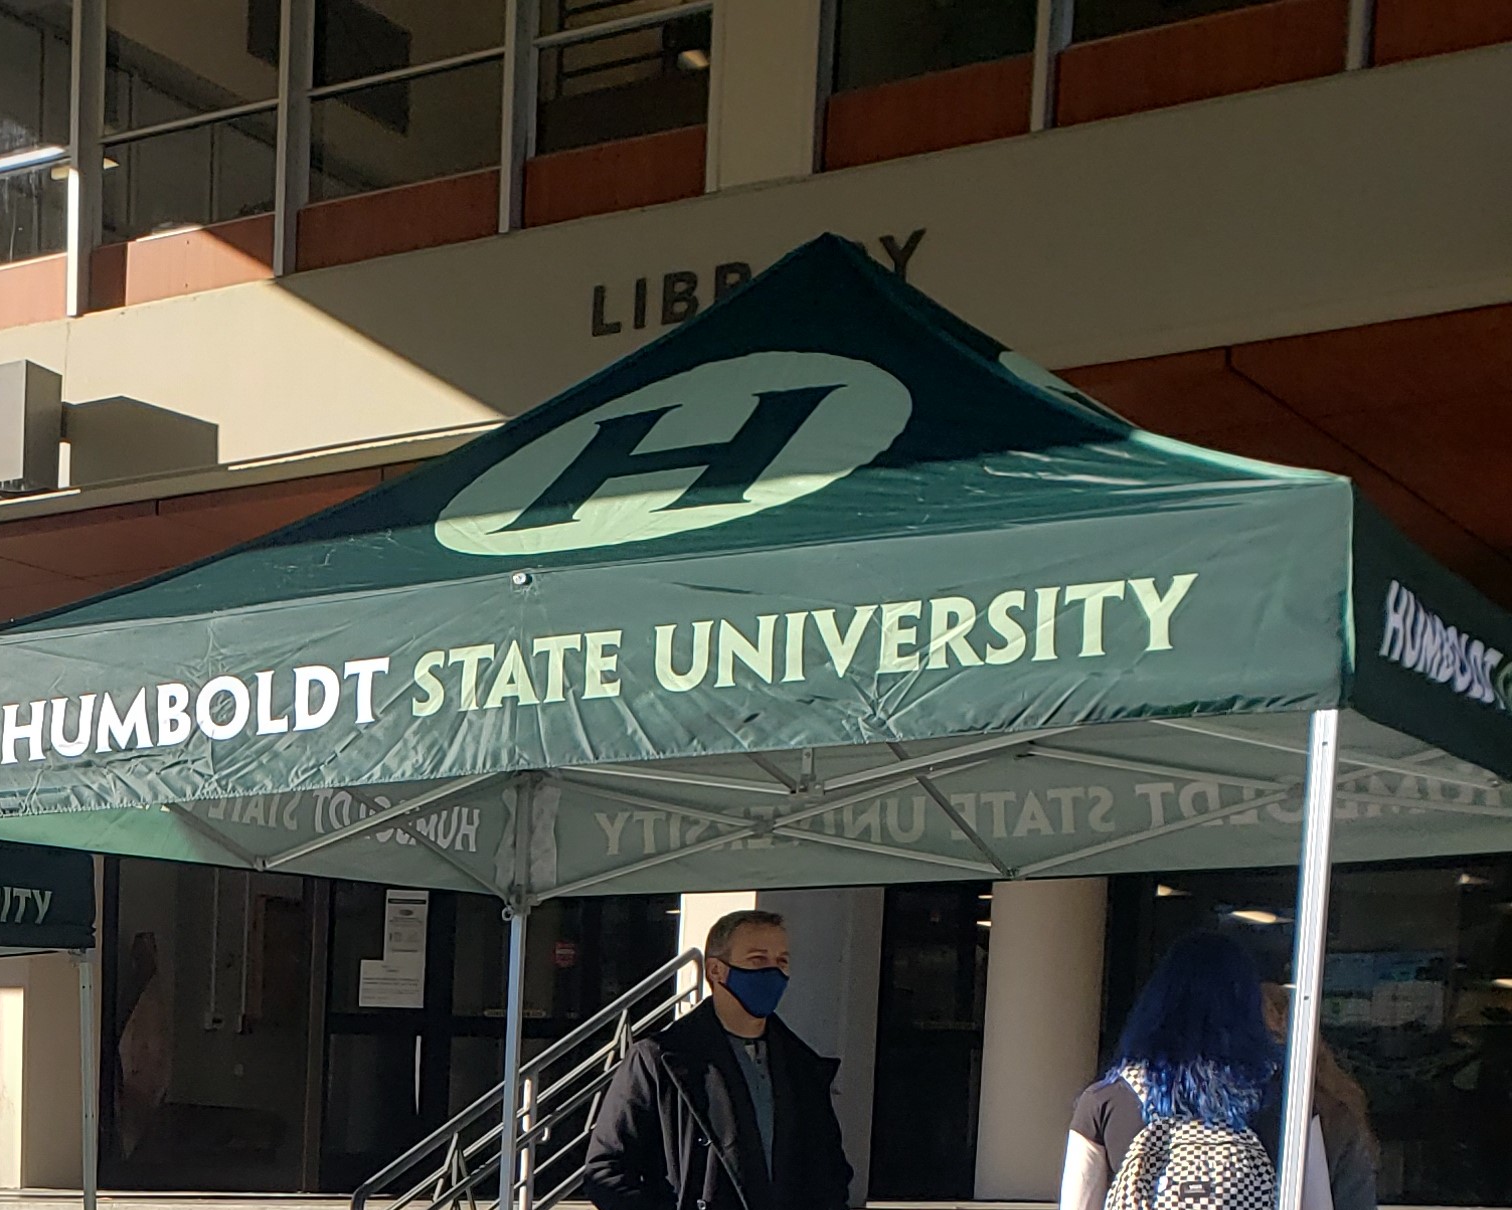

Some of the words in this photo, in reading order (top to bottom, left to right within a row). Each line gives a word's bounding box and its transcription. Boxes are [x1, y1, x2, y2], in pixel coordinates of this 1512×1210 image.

[591, 228, 926, 337] LIBRY
[1, 656, 390, 766] HUMBOLDT
[413, 629, 622, 716] STATE
[655, 573, 1198, 691] UNIVERSITY
